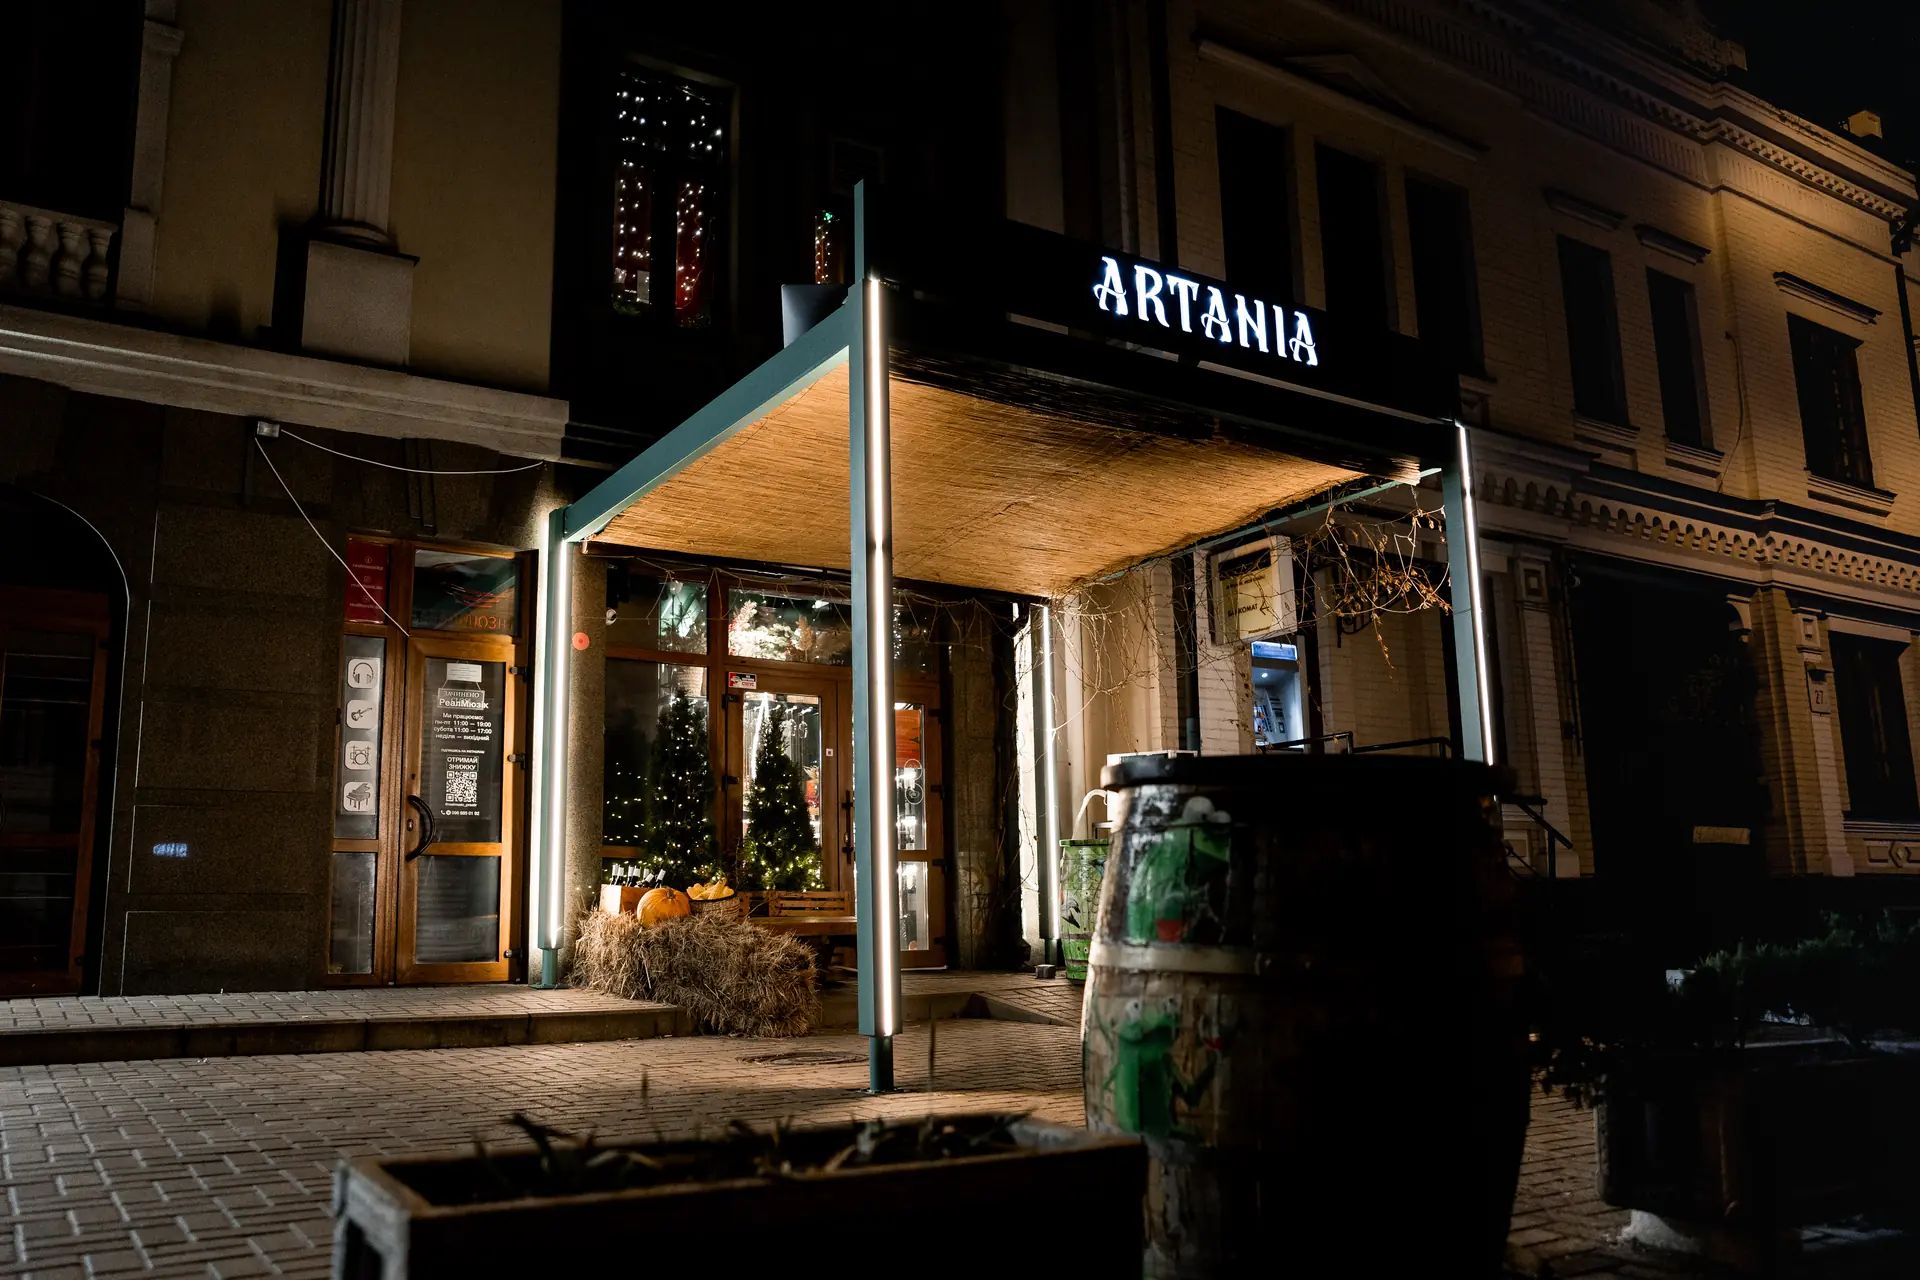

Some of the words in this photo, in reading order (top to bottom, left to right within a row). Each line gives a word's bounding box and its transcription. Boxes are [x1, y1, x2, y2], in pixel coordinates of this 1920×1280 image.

[1092, 255, 1319, 367] ARTANIA
[444, 690, 480, 698] ЗАЧИНЕНО
[1815, 690, 1824, 704] 27
